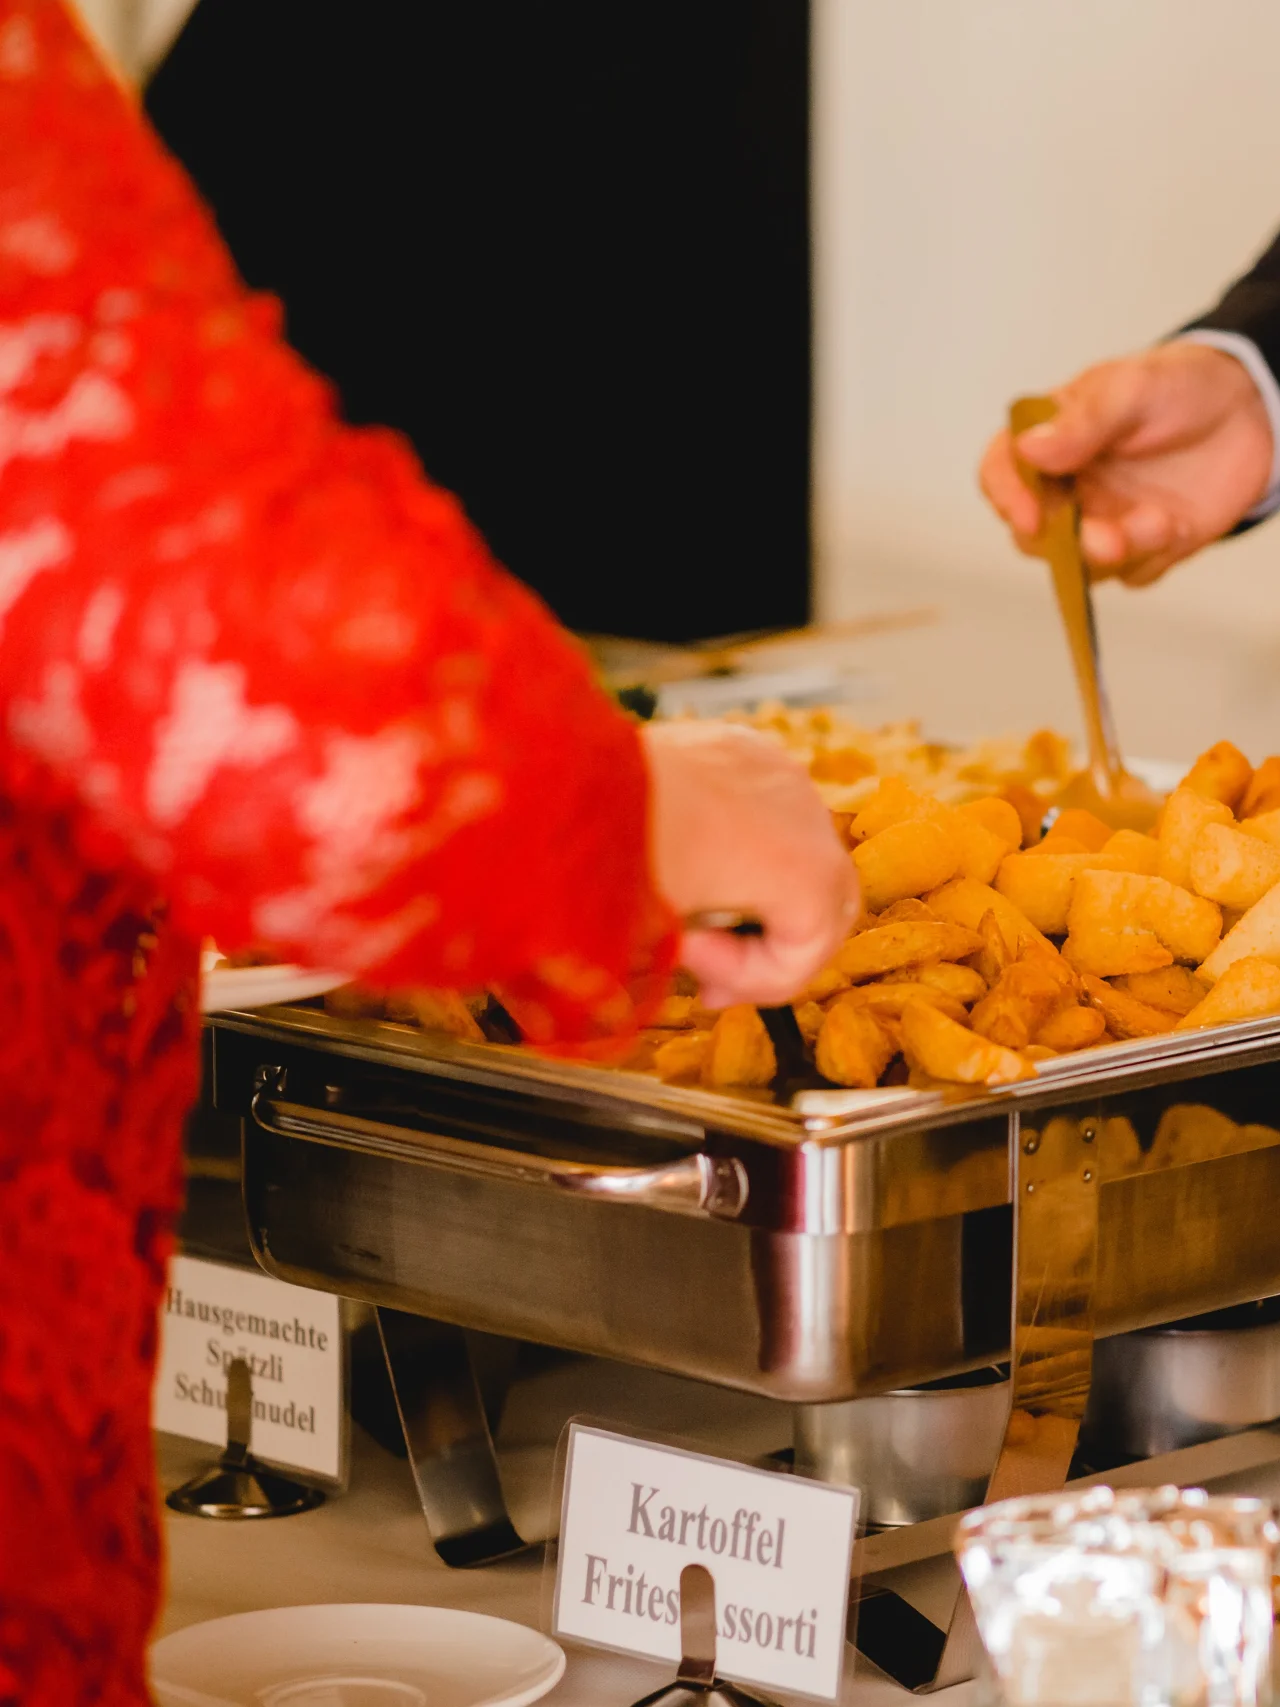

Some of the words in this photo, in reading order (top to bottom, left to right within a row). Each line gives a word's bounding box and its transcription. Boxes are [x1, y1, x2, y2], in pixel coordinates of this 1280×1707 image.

[166, 1287, 328, 1352] Hausgemachte
[206, 1338, 284, 1383] Sptzli
[174, 1372, 316, 1434] Schunudel
[626, 1482, 786, 1569] Kartoffel
[581, 1553, 681, 1626] Frites
[714, 1605, 819, 1660] ssorti
